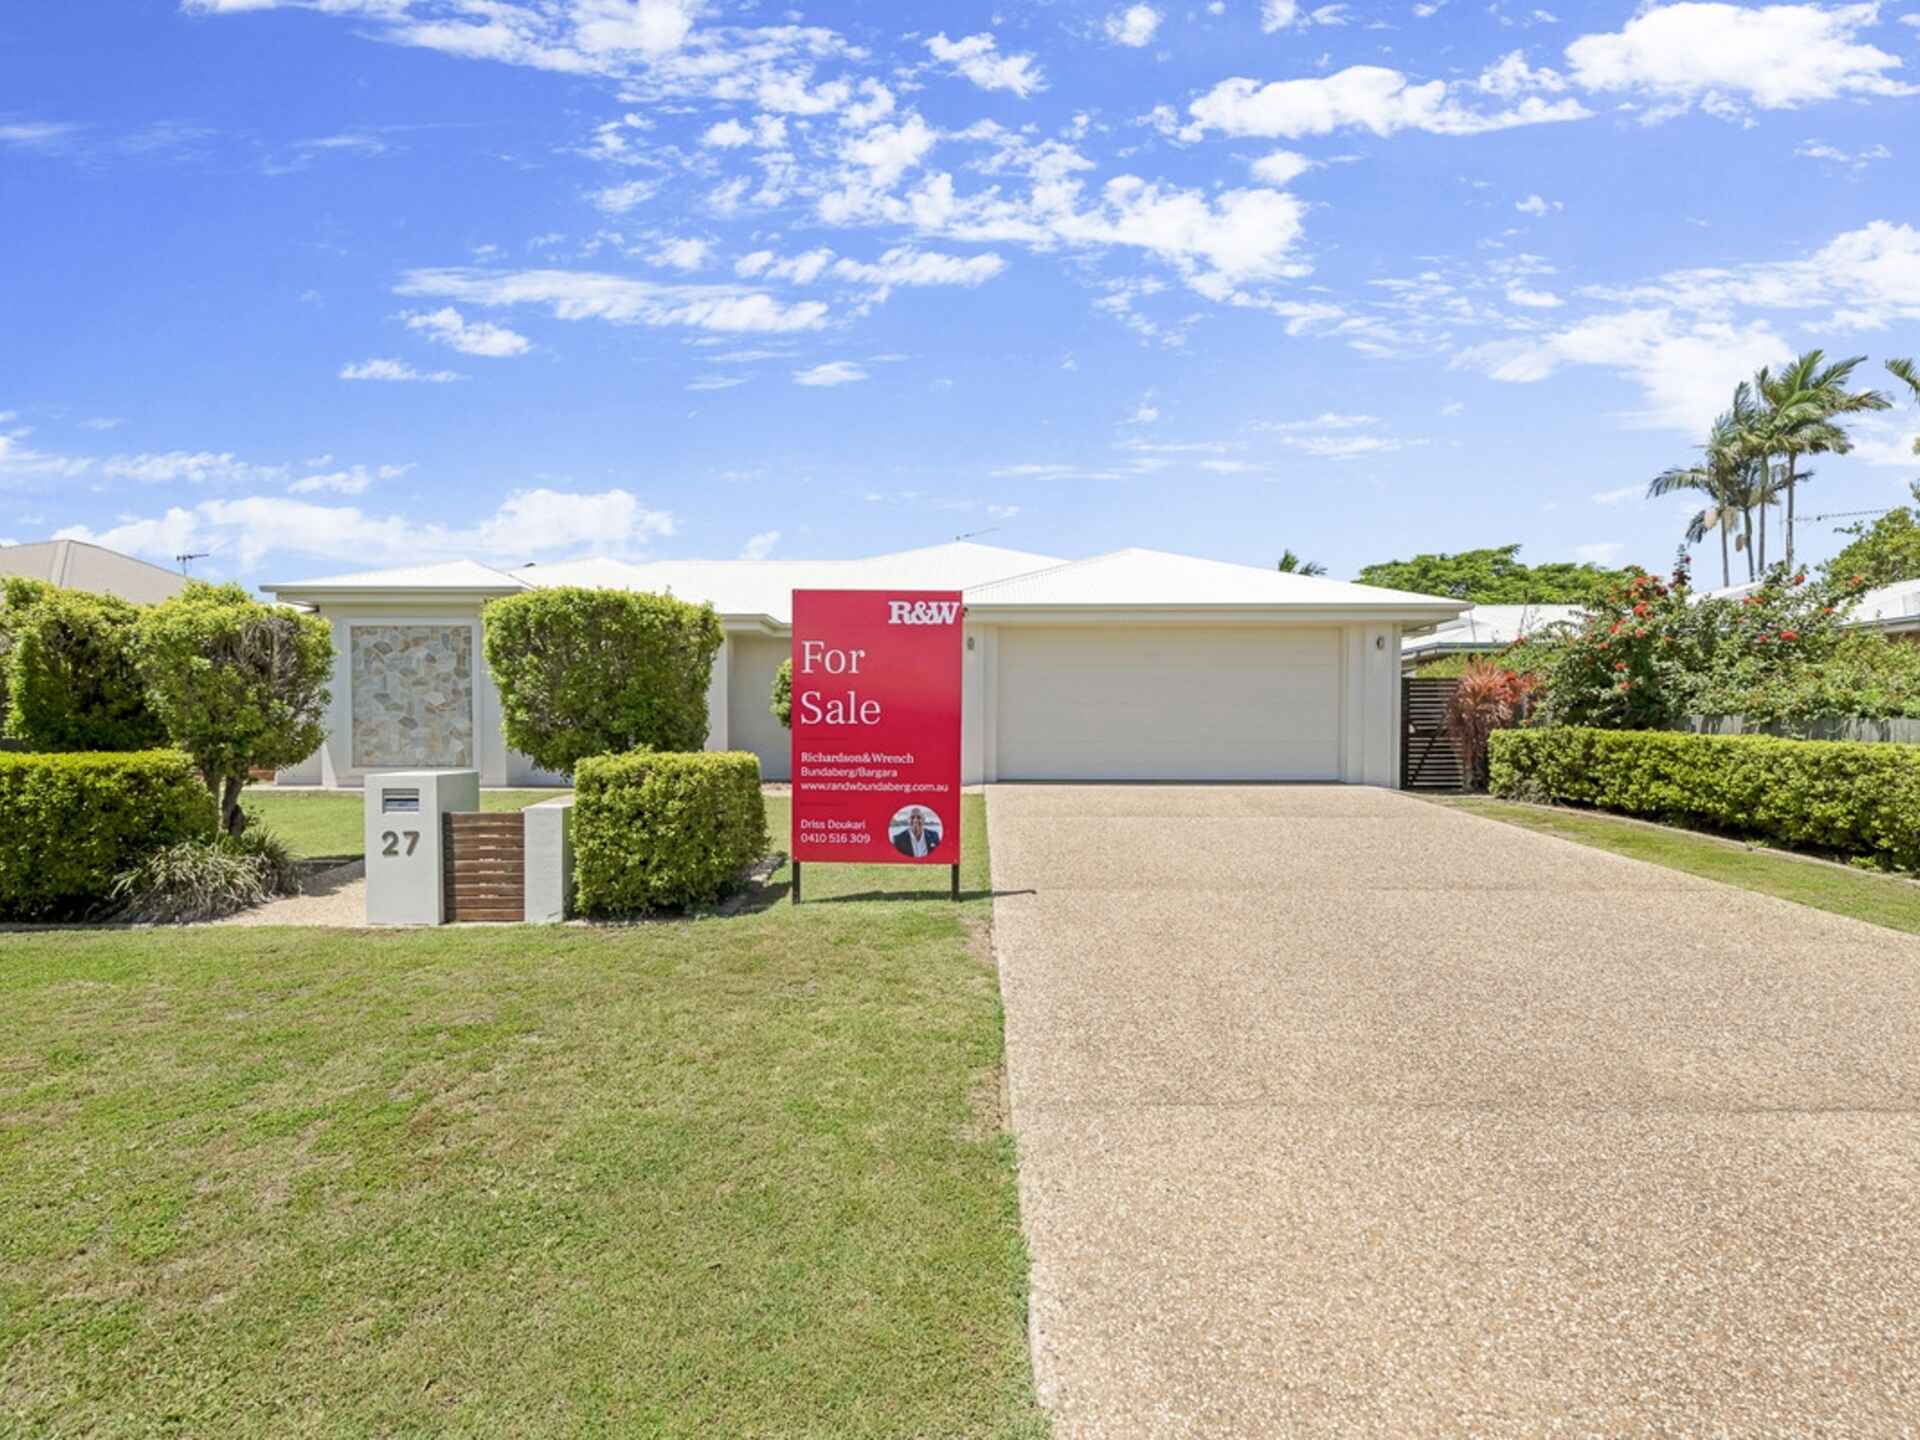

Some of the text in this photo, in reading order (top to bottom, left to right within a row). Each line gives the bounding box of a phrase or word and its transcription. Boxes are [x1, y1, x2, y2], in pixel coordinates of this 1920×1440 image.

[888, 601, 960, 625] R&W
[801, 640, 865, 674] For
[800, 691, 881, 725] Sale
[800, 767, 898, 778] Bundaberg/Bargara
[800, 782, 948, 793] www.randwbundaberg.com.au
[801, 820, 866, 829] Driss Doukari
[381, 830, 420, 857] 27
[801, 833, 871, 844] 0410 516 309
